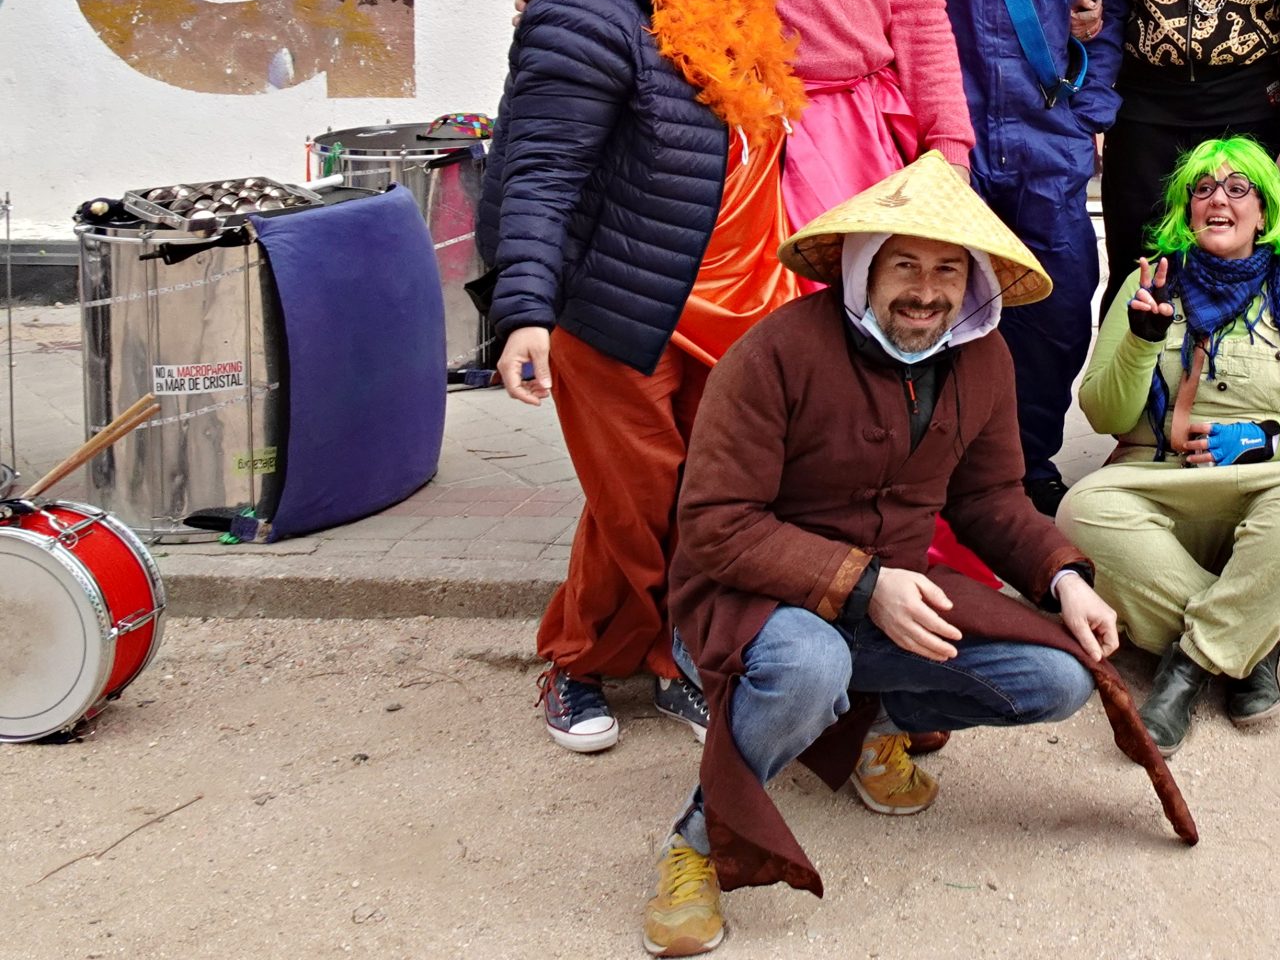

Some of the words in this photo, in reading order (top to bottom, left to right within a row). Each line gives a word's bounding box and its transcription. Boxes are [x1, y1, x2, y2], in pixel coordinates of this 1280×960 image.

[155, 367, 166, 379] NO
[167, 368, 175, 379] AL
[156, 382, 164, 391] EN
[165, 378, 186, 392] MAR
[188, 377, 201, 391] DE
[203, 373, 243, 390] CRISTAL
